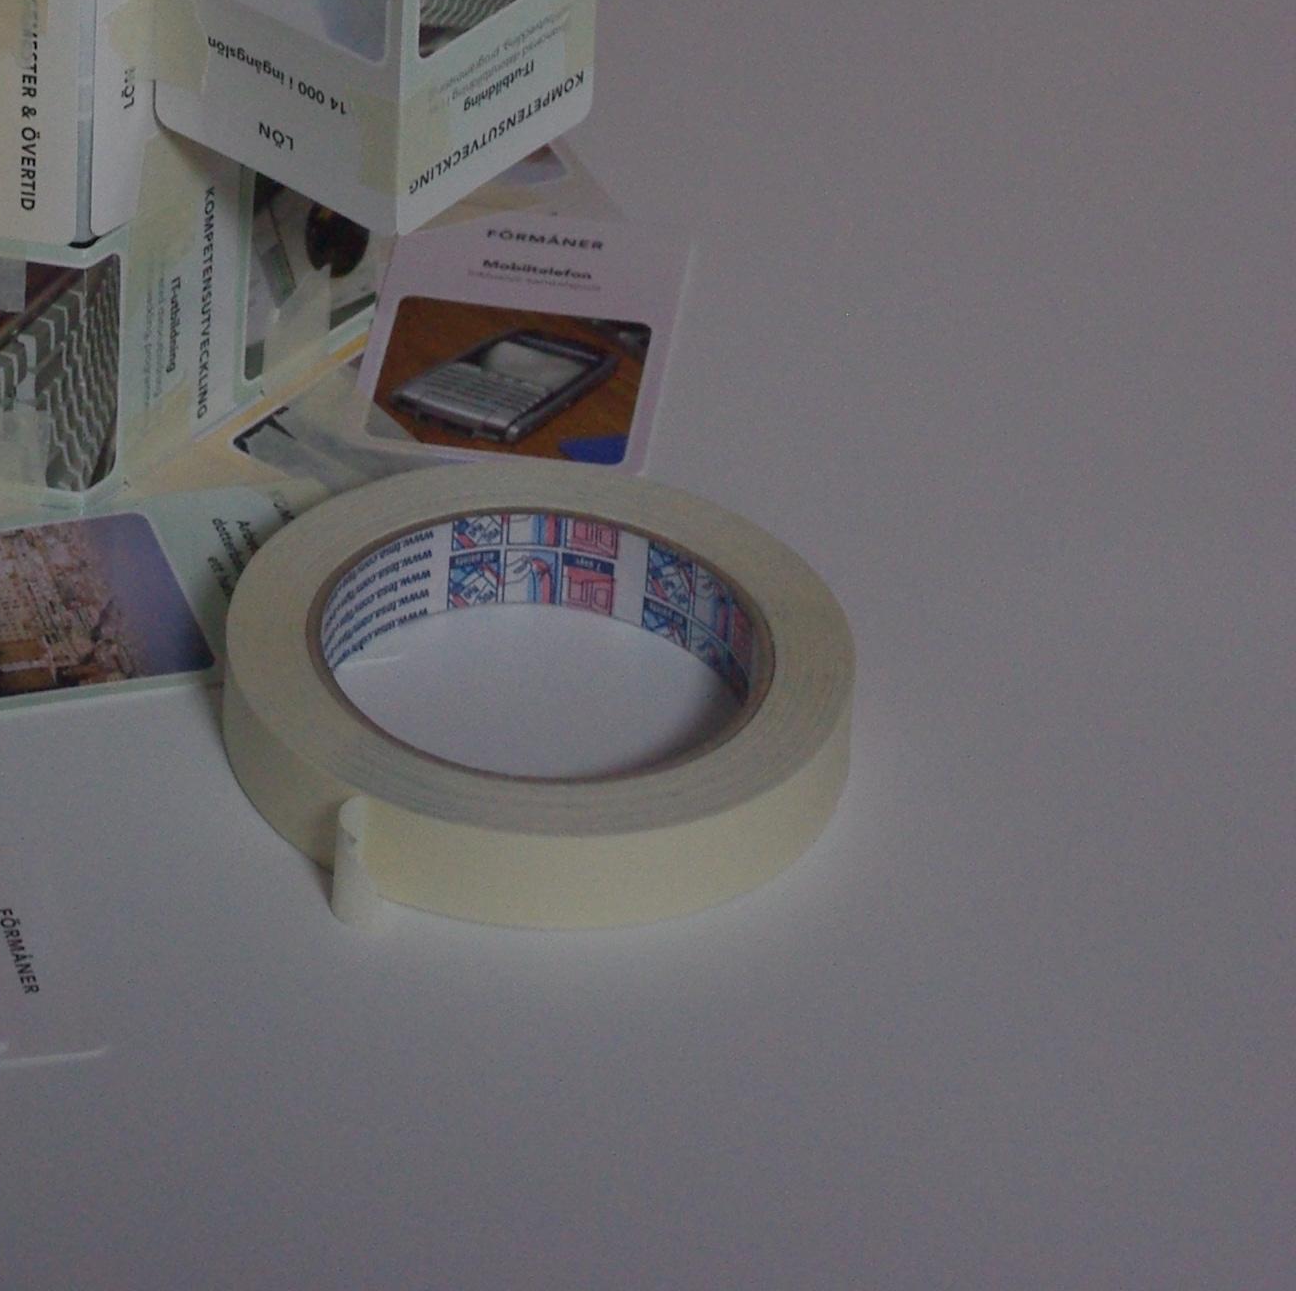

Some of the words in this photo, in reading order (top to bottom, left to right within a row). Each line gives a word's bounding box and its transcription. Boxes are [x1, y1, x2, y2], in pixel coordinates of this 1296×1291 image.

[207, 35, 286, 86] ingångslön
[295, 80, 325, 107] 000
[21, 105, 37, 119] &
[257, 121, 295, 151] LÖN
[407, 68, 585, 195] KOMPETENSUTVECKLING
[20, 127, 40, 212] ÖVERTID
[485, 227, 604, 251] FÖRMÅNER
[482, 258, 593, 282] Mobiltelefon
[197, 186, 216, 420] KOMPETENSUTVECKLING
